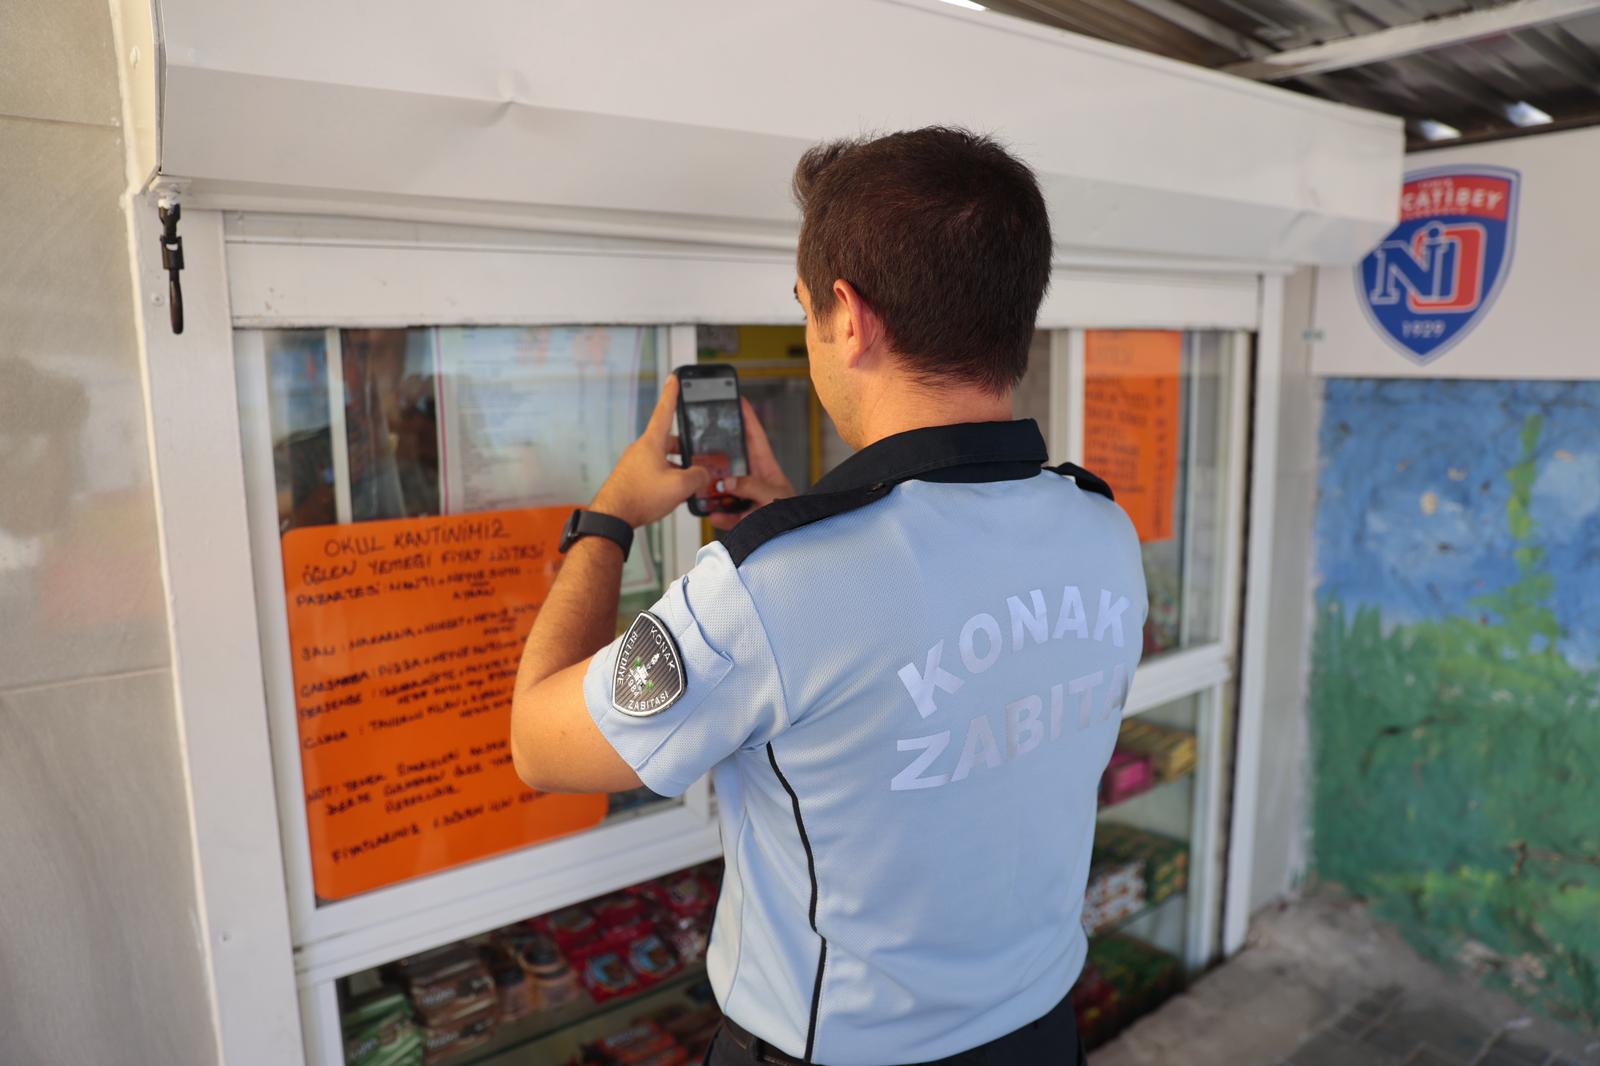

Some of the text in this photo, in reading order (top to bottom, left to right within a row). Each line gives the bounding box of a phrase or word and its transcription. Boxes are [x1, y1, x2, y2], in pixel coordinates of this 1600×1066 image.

[1402, 320, 1446, 338] 1929
[324, 536, 385, 558] OKUL
[650, 626, 676, 672] KONAK
[897, 585, 1130, 719] KONAK
[627, 690, 669, 712] ZABITASI
